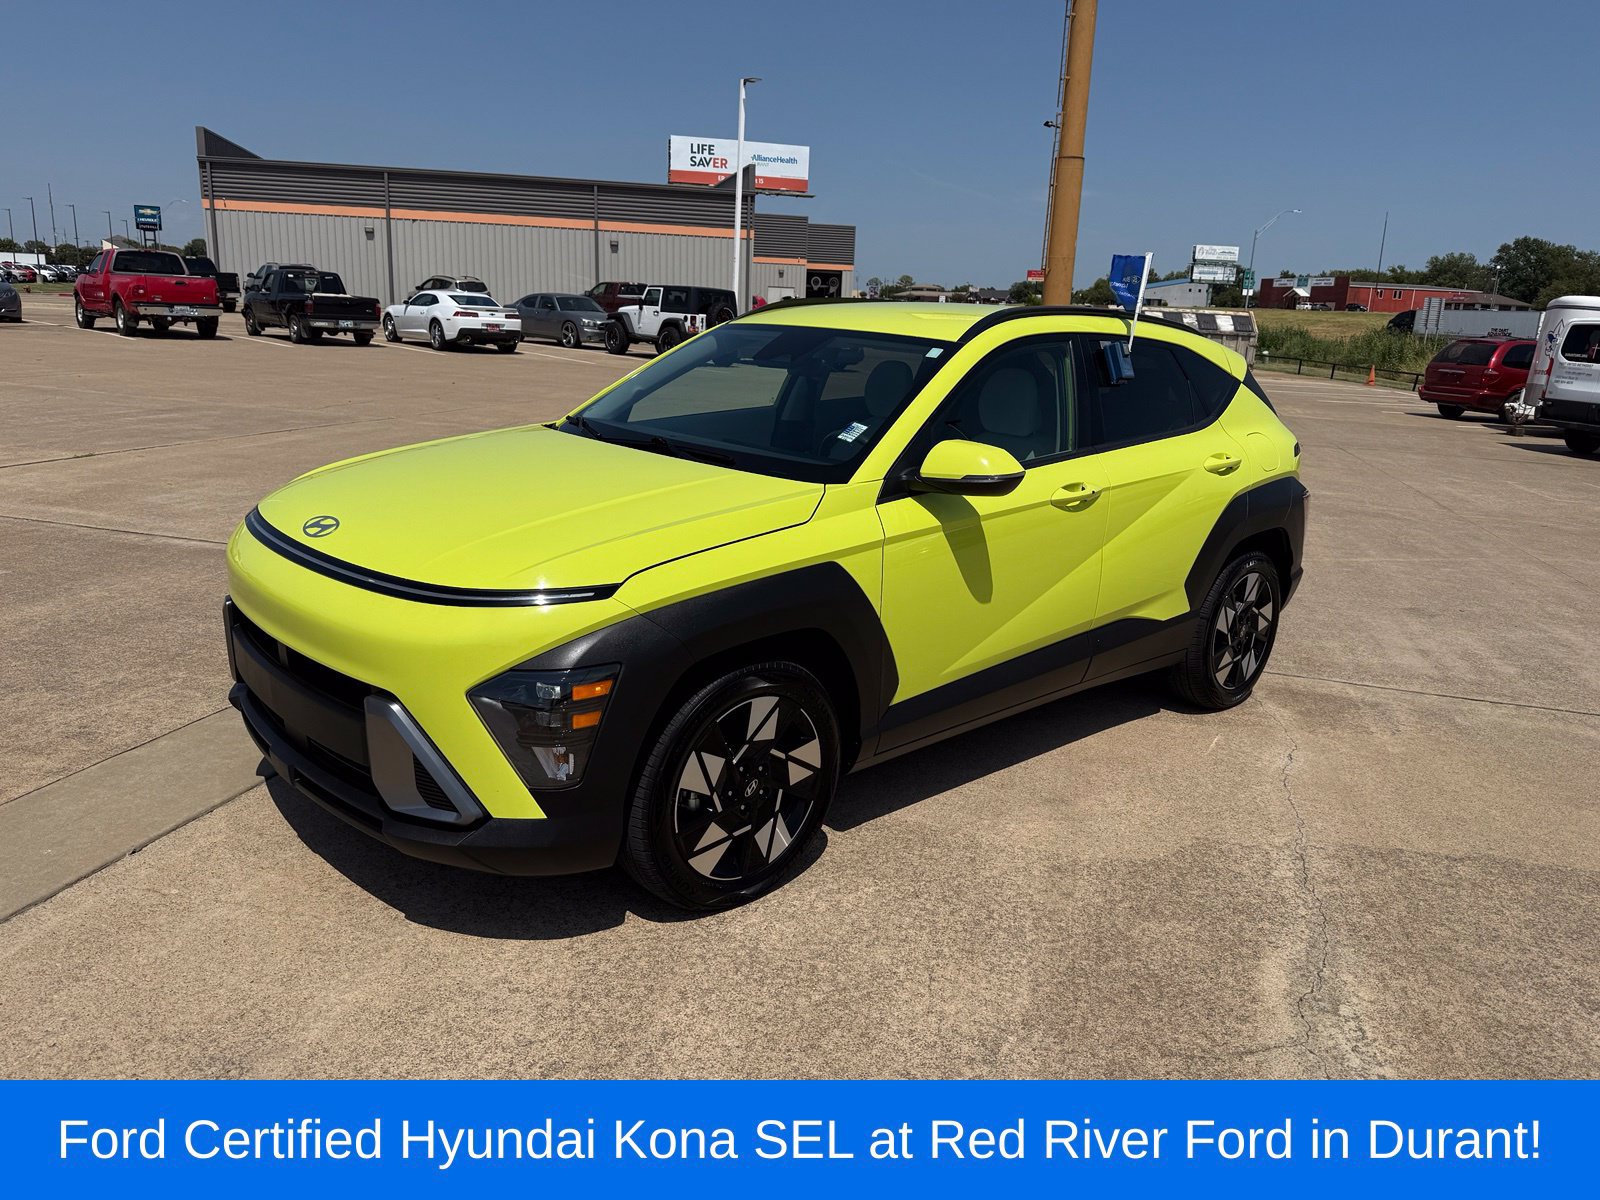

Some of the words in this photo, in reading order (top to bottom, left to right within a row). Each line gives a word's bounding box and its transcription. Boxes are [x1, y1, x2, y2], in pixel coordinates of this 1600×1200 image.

[690, 143, 715, 155] LIFE
[690, 156, 728, 169] SAVER
[751, 154, 798, 164] AllianceHealth
